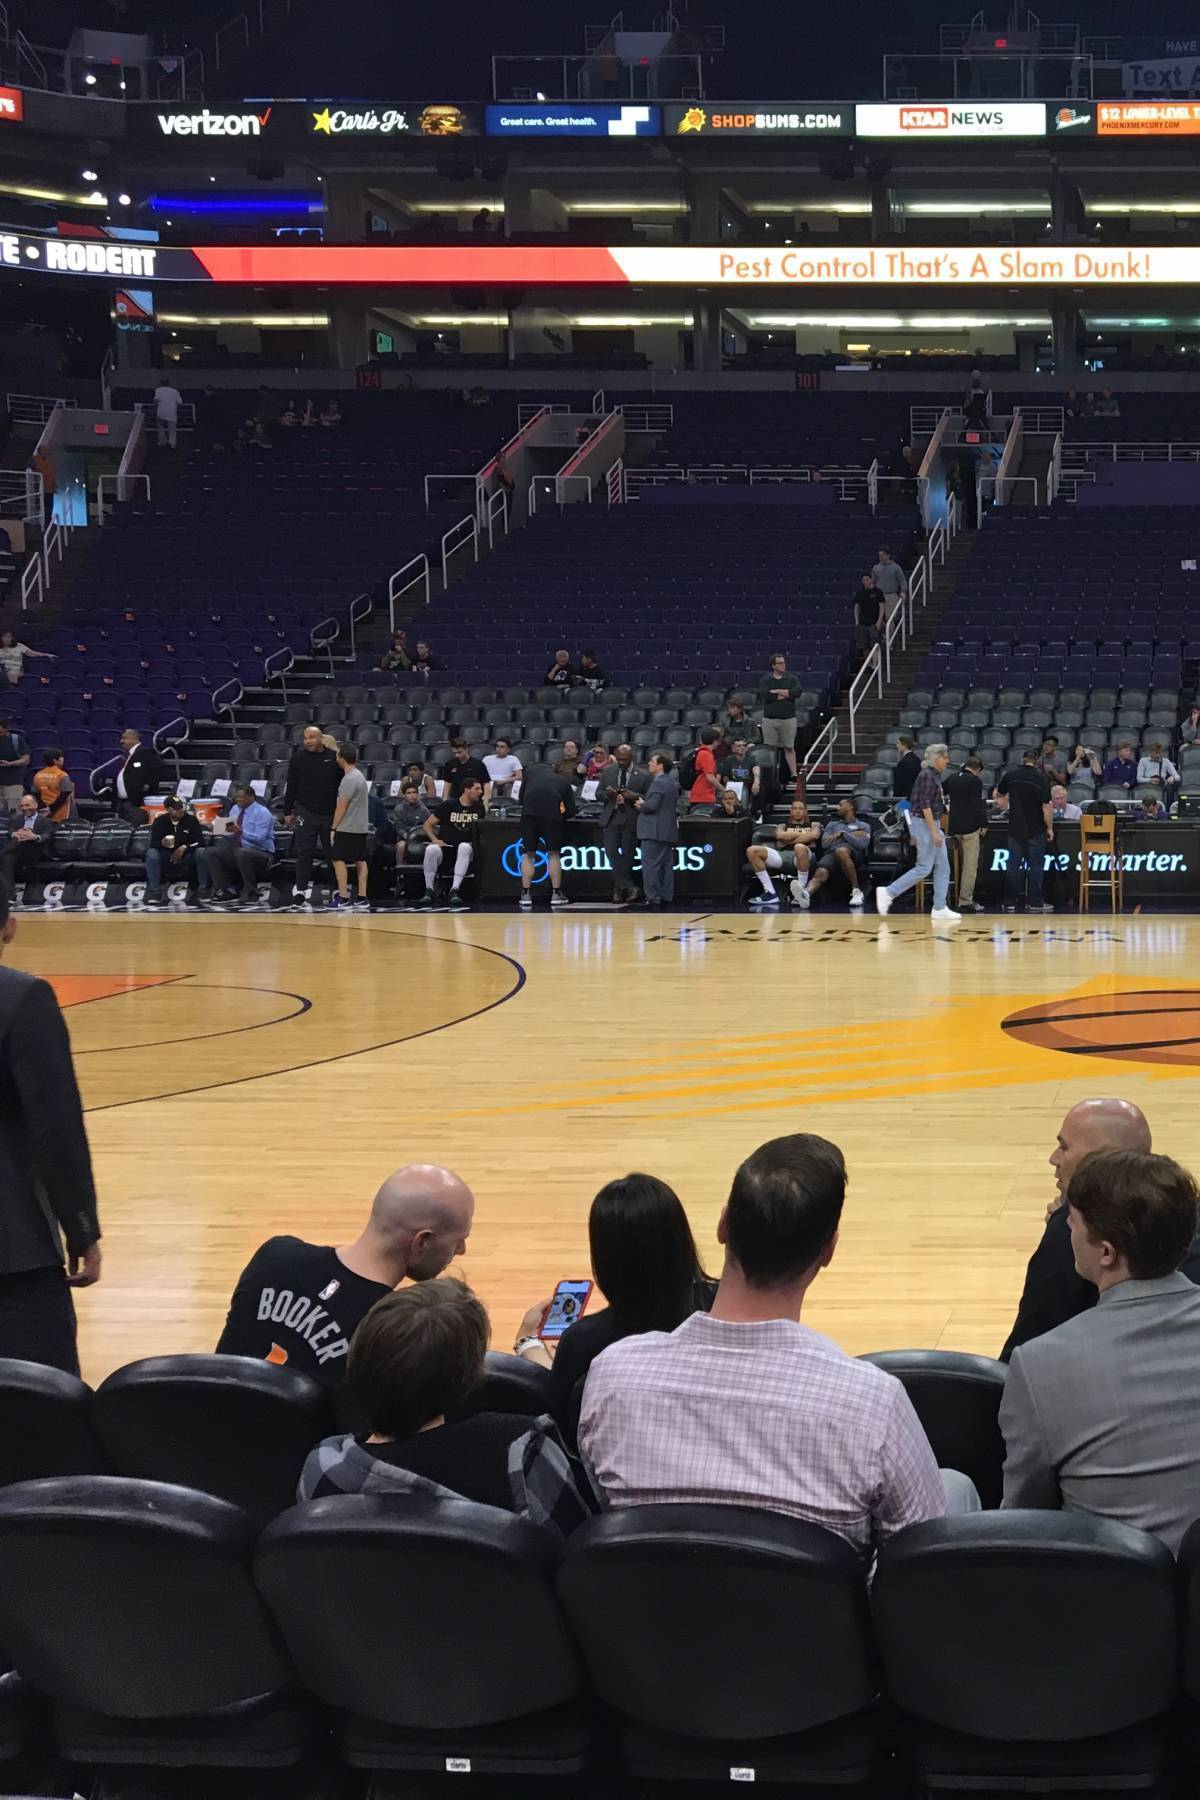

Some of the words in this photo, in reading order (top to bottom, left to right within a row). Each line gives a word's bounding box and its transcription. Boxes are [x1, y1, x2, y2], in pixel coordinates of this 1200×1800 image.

[1165, 40, 1198, 51] HAVE
[1129, 64, 1182, 86] Text
[711, 114, 841, 128] SHOPSUNS.COM
[902, 110, 947, 127] KTAR
[951, 111, 1004, 125] NEWS
[1122, 107, 1190, 120] LOWER-LEVEL
[158, 109, 261, 135] verizon
[329, 110, 380, 133] Carl's
[500, 117, 522, 126] Great
[524, 118, 544, 126] care.
[545, 117, 568, 126] Great
[569, 117, 597, 126] health.
[1101, 121, 1180, 129] PHOENIXMERCURY.COM
[46, 241, 157, 276] RODENT
[720, 253, 771, 278] Pest
[780, 252, 876, 278] Control
[885, 253, 959, 278] That's
[970, 254, 990, 278] A
[1000, 252, 1063, 278] Slam
[1074, 252, 1151, 278] Dunk!
[797, 373, 817, 388] 101
[449, 811, 479, 822] BUCKS
[256, 1287, 349, 1365] BOOKER
